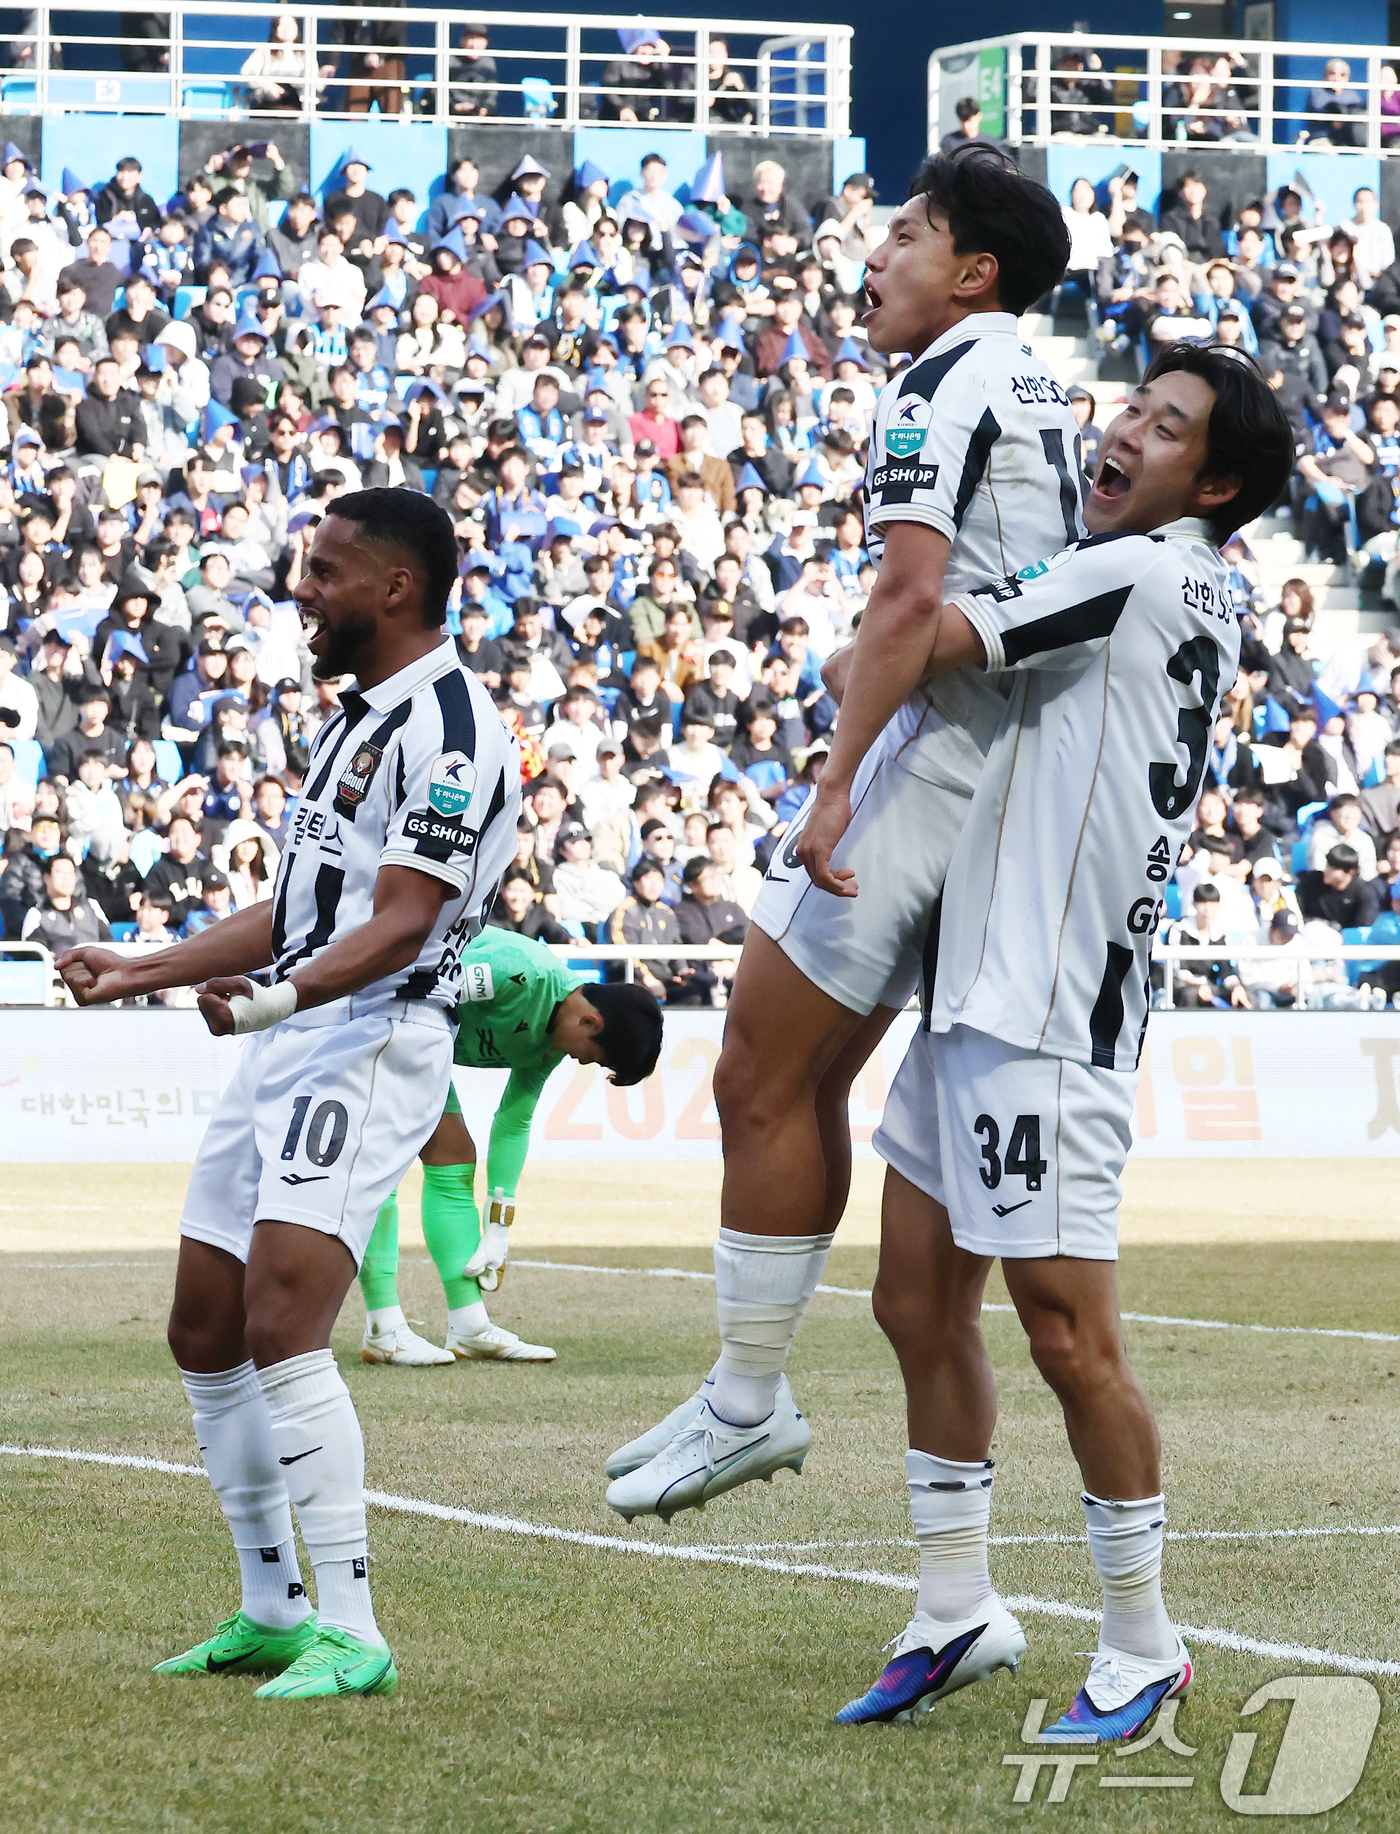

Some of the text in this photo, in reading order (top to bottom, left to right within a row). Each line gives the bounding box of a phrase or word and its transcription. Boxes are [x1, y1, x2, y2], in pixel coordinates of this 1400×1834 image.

[94, 79, 121, 103] E3
[980, 67, 1003, 101] E4
[873, 468, 935, 487] GS SHOP
[340, 761, 370, 794] Seoul
[407, 818, 474, 847] GS SHOP
[473, 965, 487, 999] GNM
[281, 1096, 349, 1168] 10
[974, 1113, 1048, 1192] 34
